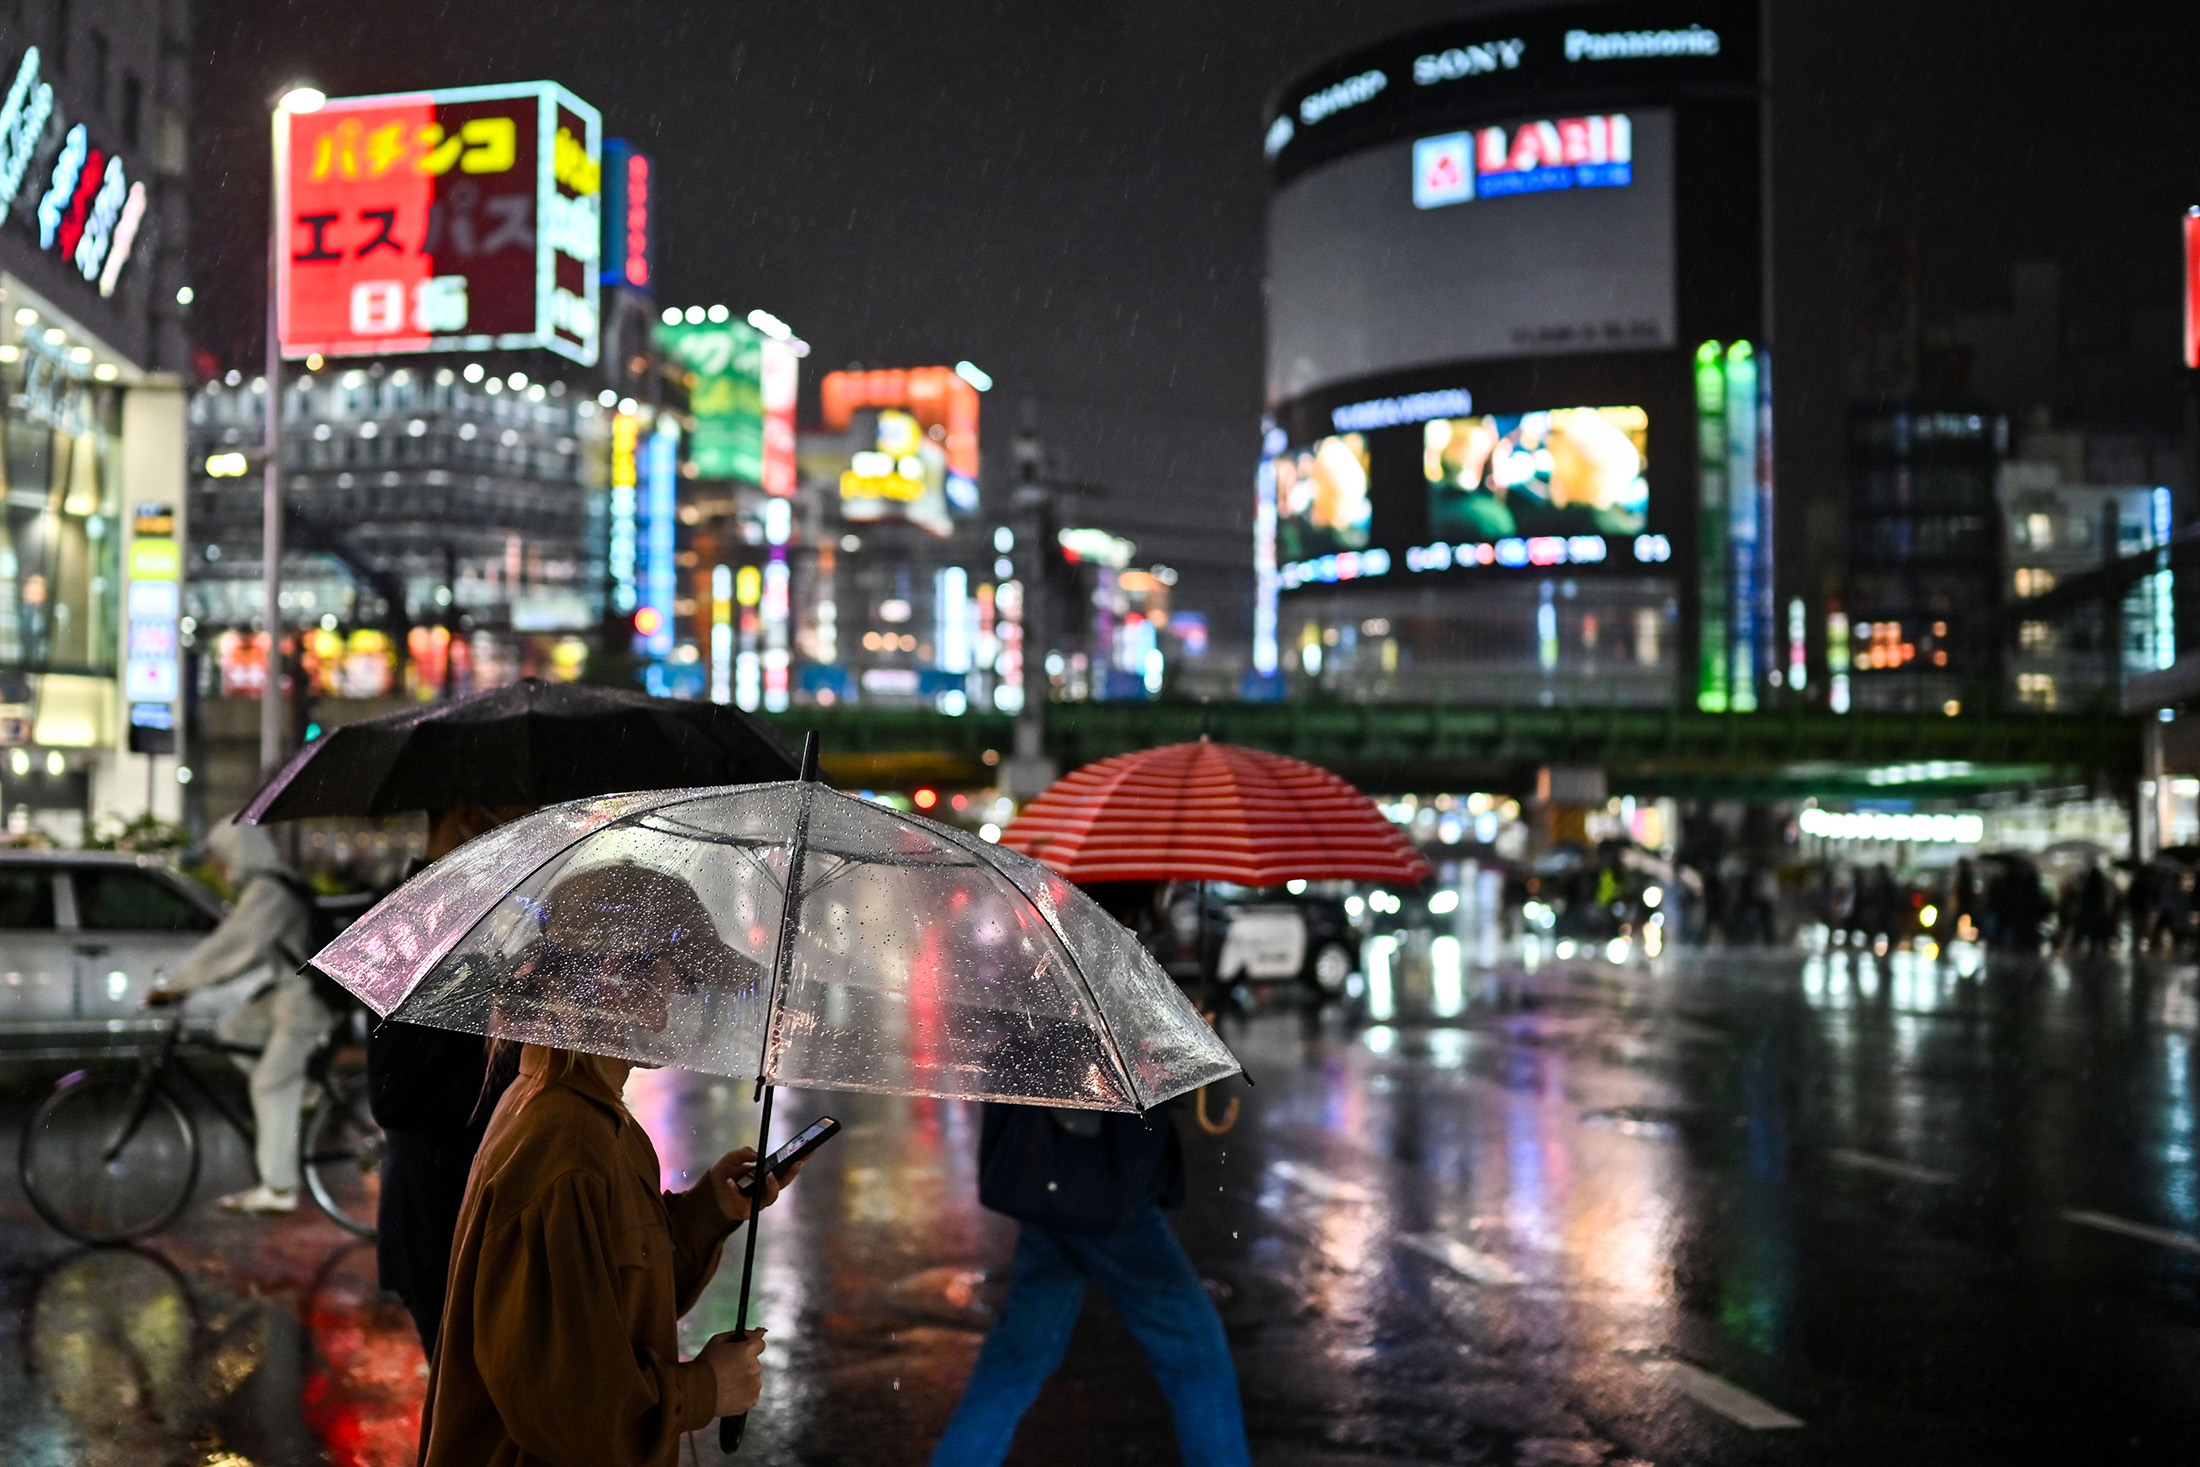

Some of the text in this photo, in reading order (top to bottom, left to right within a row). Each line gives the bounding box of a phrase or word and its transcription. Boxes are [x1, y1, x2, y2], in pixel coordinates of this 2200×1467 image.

[1413, 38, 1525, 85] SONY
[1564, 24, 1719, 62] Panasonic
[310, 117, 516, 182] パチンコ
[1476, 113, 1631, 173] LABI
[294, 181, 537, 261] エスパス
